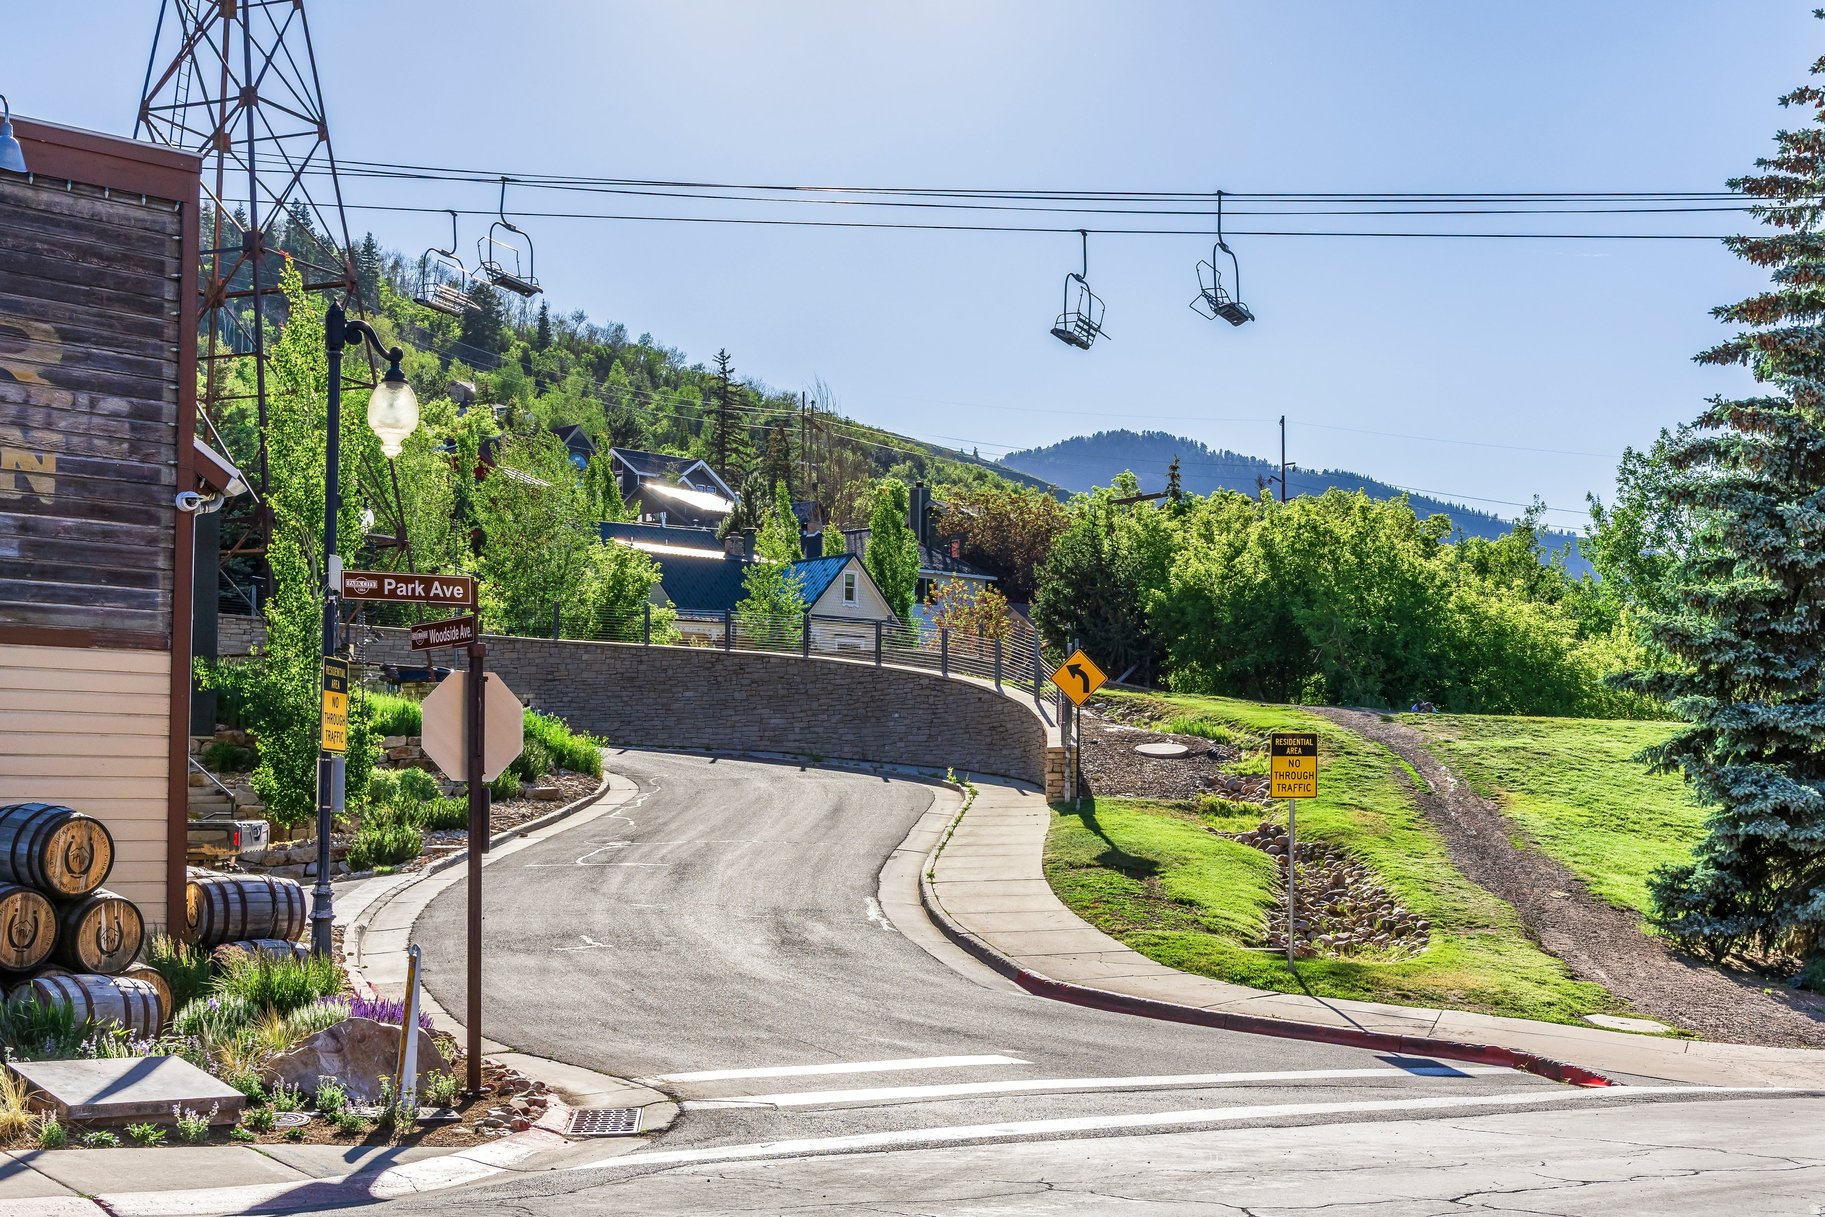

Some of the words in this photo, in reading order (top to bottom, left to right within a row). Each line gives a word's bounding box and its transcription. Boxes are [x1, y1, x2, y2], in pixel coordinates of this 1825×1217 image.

[384, 578, 426, 597] Park
[429, 580, 464, 598] Ave
[428, 625, 459, 644] Woodside
[325, 665, 346, 679] RESIDENTIAL
[331, 679, 341, 690] AREA
[331, 696, 340, 709] NO
[324, 711, 346, 727] THROUGH
[325, 729, 344, 744] TRAFFIC
[1275, 738, 1314, 746] RESIDENTIAL
[1286, 747, 1303, 755] AREA
[1288, 759, 1301, 768] NO
[1274, 771, 1315, 780] THROUGH
[1276, 783, 1312, 792] TRAFFIC
